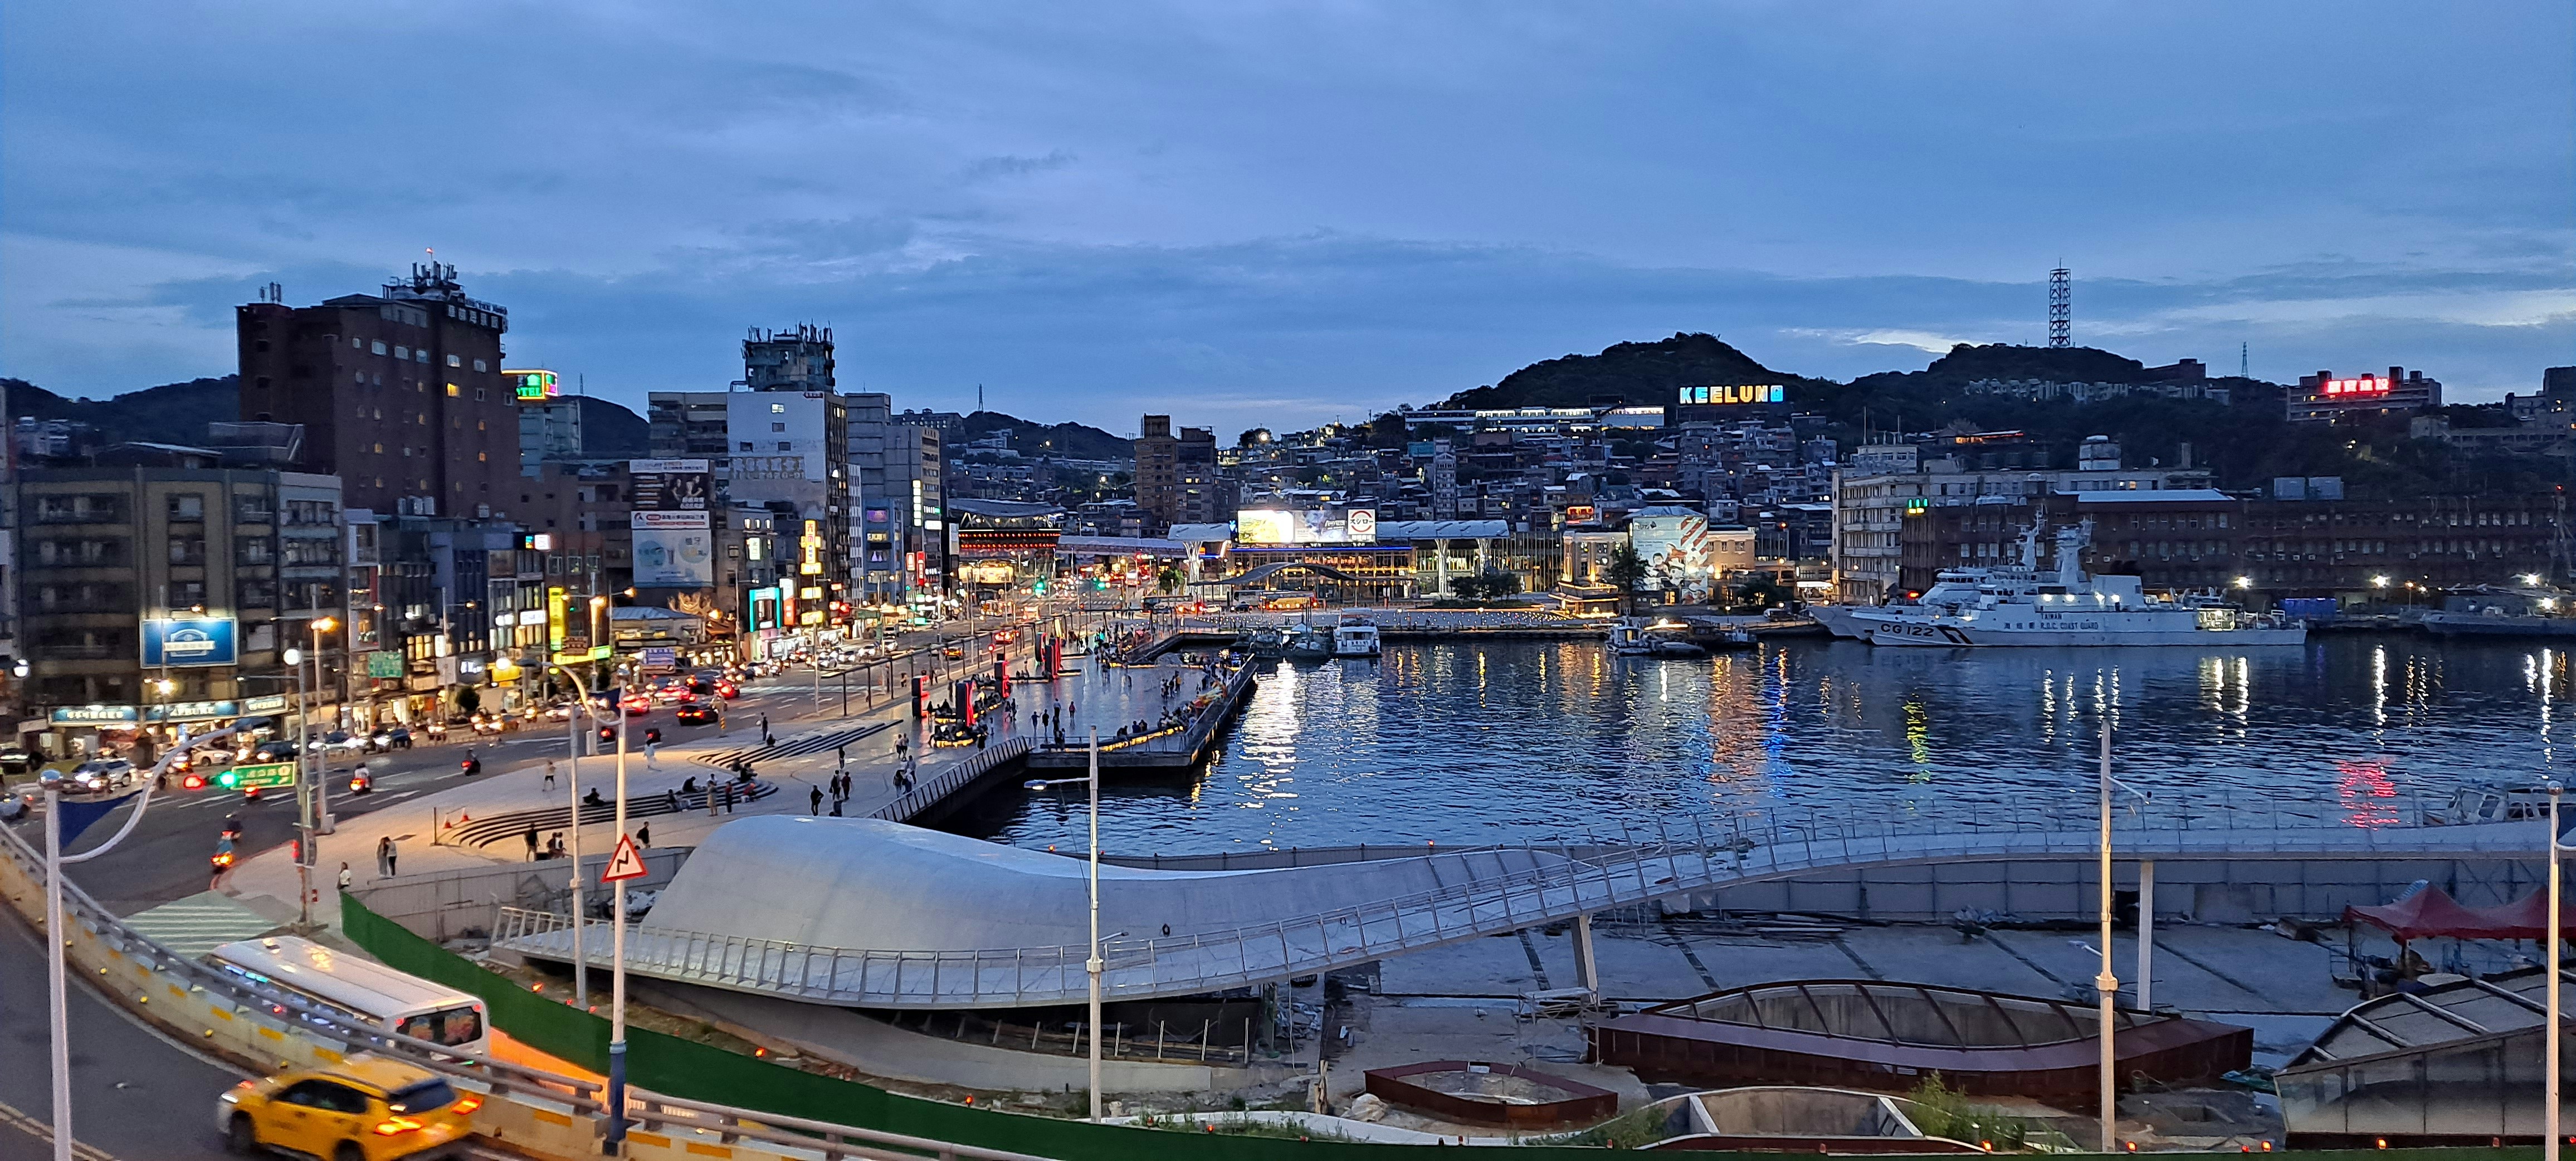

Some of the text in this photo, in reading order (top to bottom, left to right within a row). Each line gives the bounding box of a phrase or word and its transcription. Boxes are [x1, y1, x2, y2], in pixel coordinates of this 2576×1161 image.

[1680, 385, 1783, 404] KEELUNG
[1881, 623, 1934, 637] CG 122
